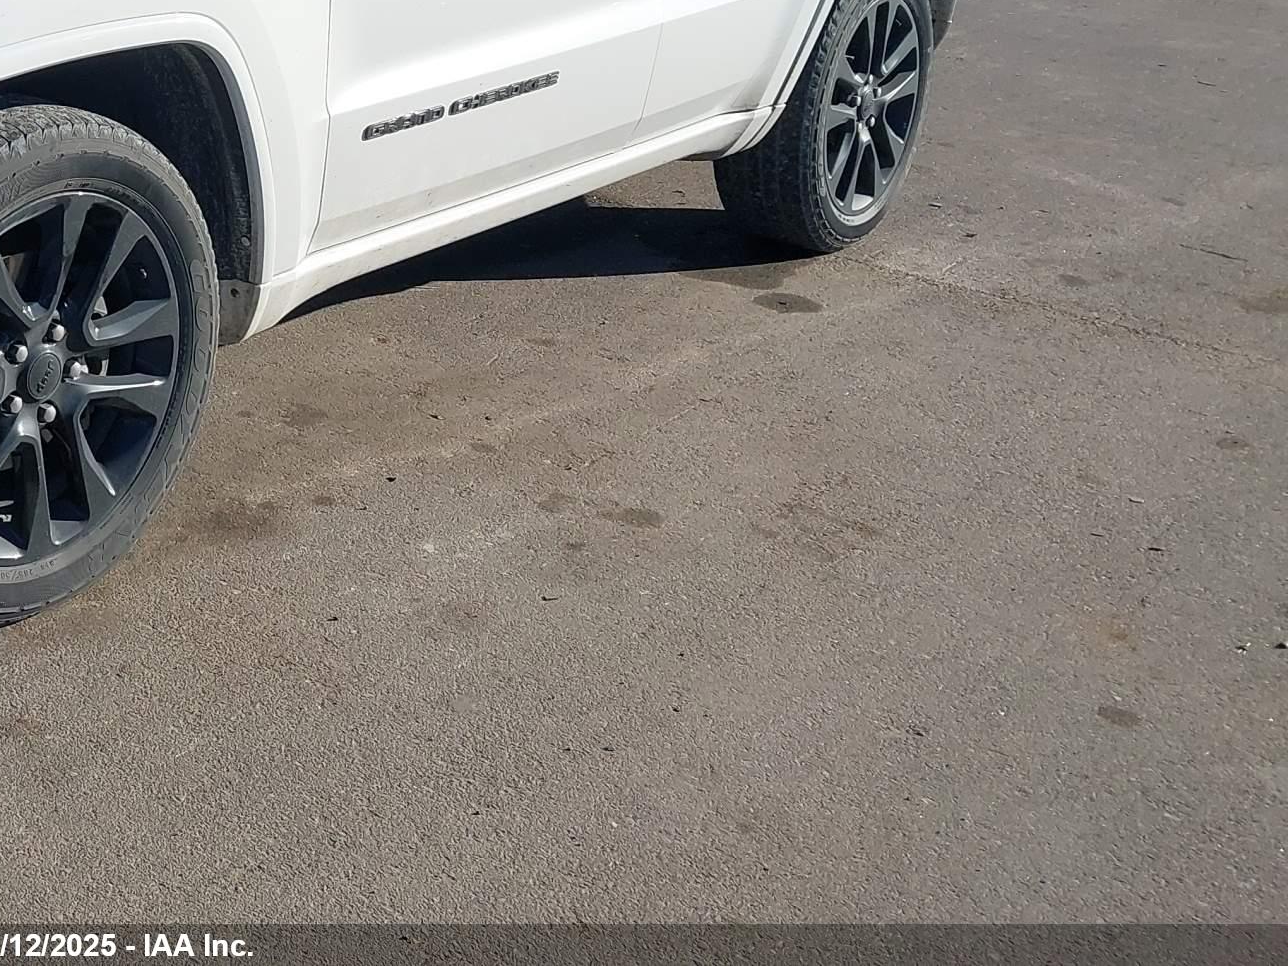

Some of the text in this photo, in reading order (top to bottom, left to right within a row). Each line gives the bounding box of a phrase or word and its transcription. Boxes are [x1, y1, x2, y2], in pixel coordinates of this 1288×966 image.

[361, 70, 560, 142] GRAND CHEROKEE
[36, 359, 54, 394] Jeep
